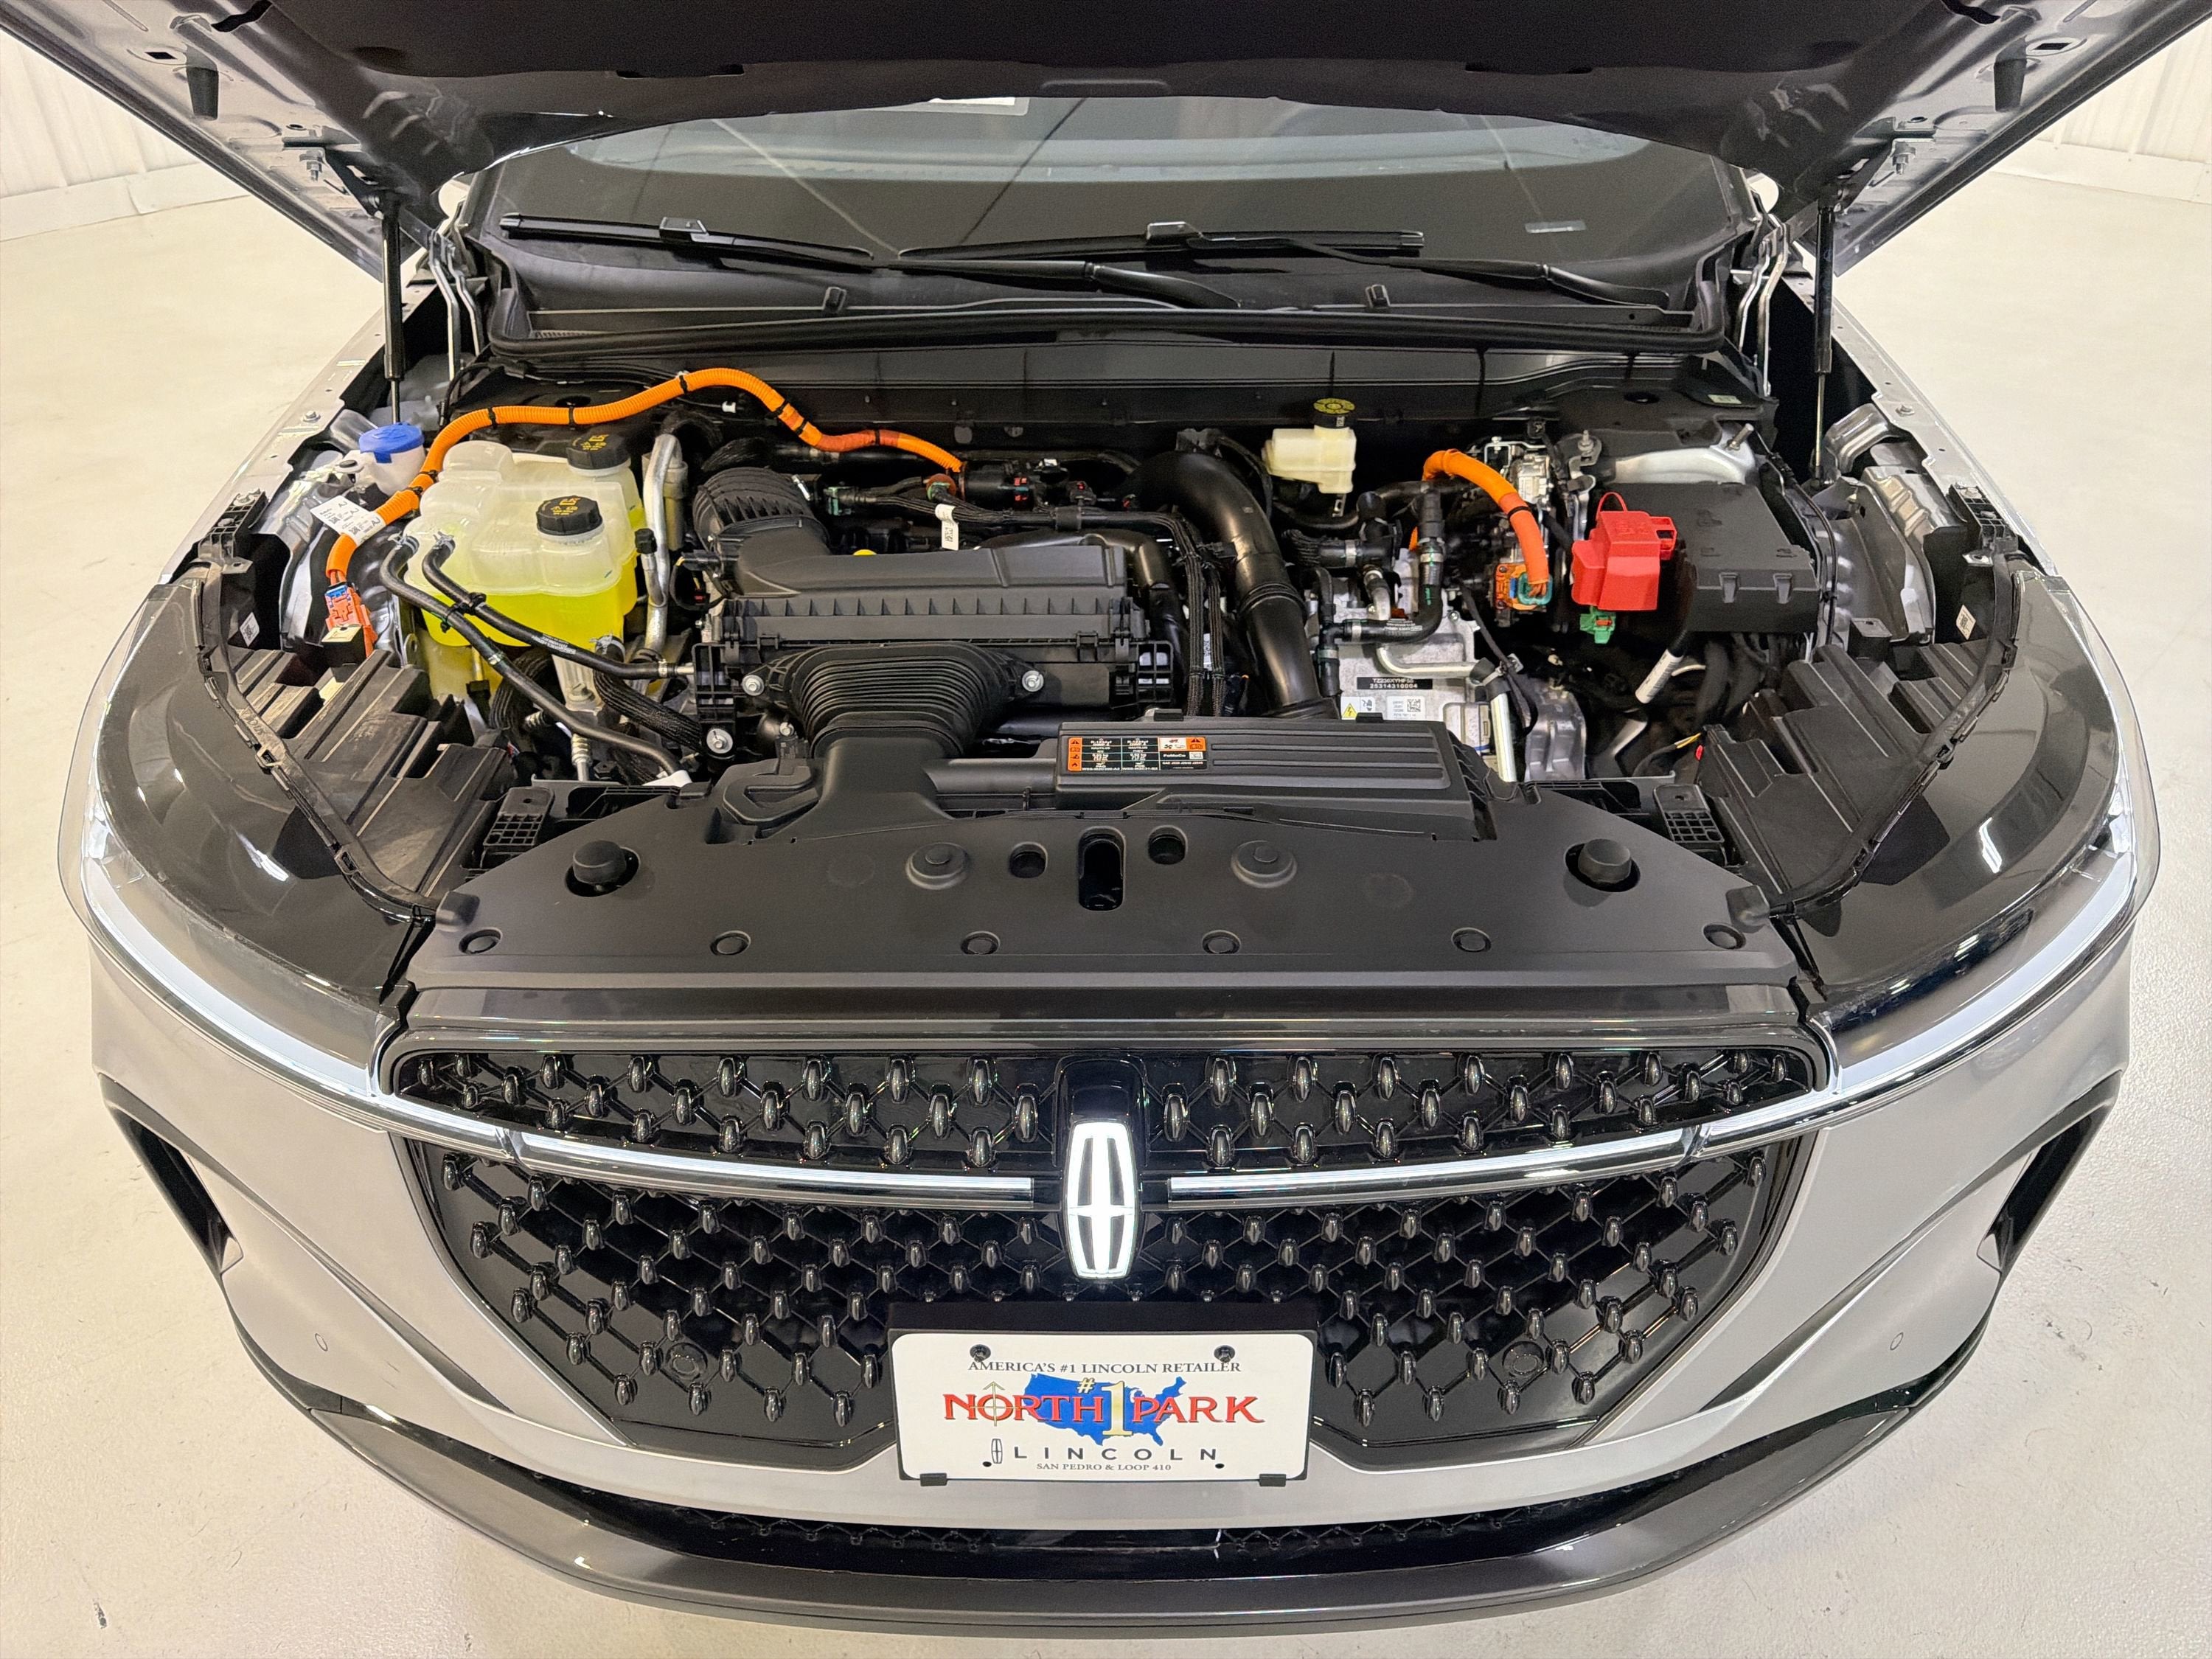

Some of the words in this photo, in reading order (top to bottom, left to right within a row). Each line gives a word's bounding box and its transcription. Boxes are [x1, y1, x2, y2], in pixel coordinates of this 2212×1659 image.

[967, 1361, 1056, 1373] AMERICA'S
[1060, 1363, 1077, 1374] #1
[1082, 1363, 1158, 1374] LINCOLN
[1162, 1362, 1242, 1373] RETAILER
[942, 1394, 1105, 1423] NORTH
[1132, 1396, 1266, 1423] PARK
[1014, 1446, 1217, 1461] LINCOLN
